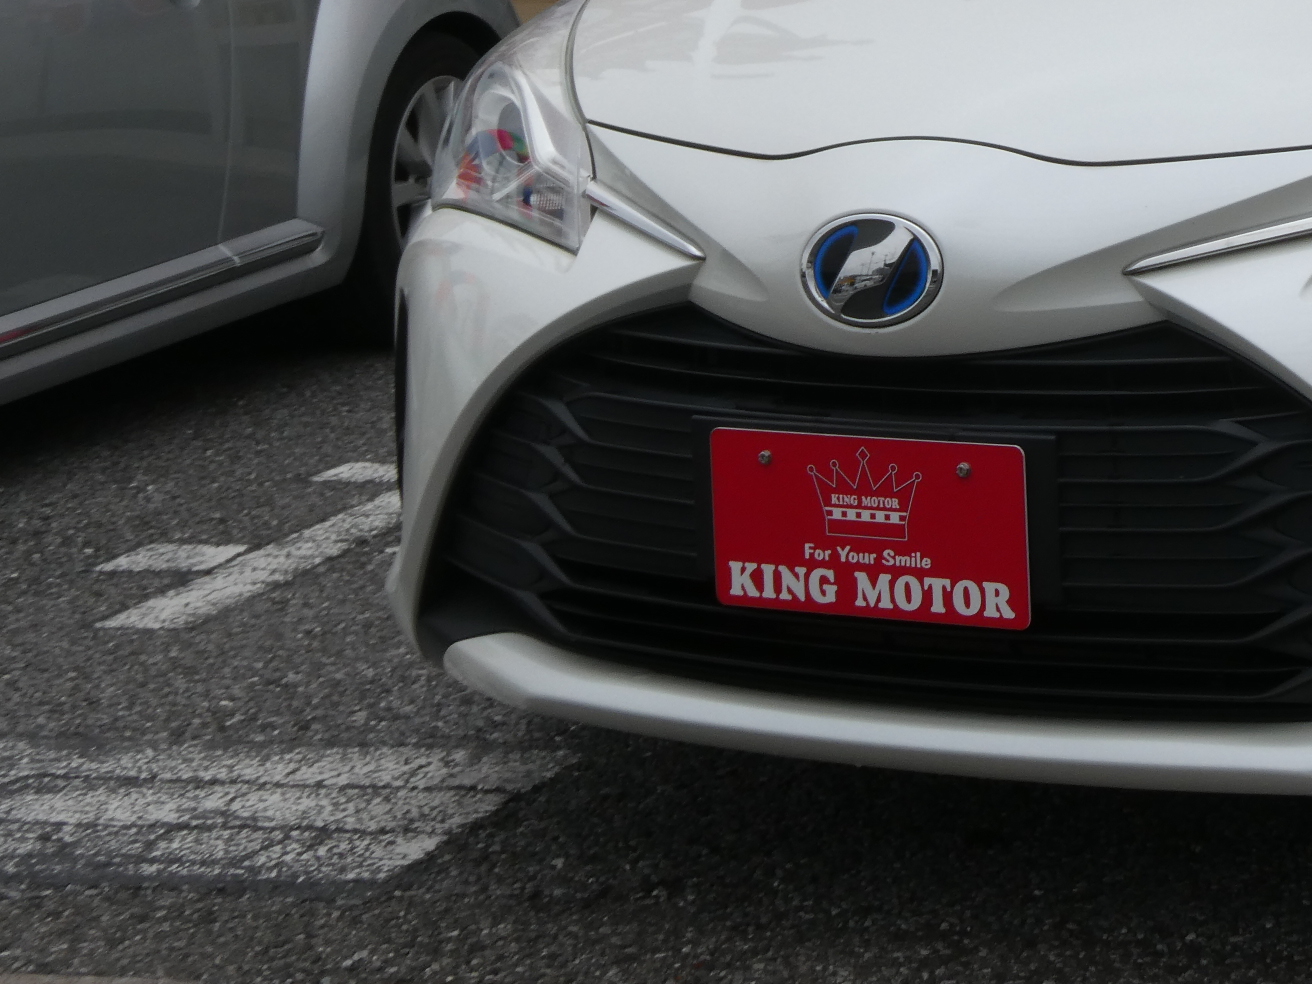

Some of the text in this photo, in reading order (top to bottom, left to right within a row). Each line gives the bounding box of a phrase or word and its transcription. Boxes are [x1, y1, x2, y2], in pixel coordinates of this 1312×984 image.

[831, 494, 900, 509] KING MOTOR
[804, 543, 931, 569] For Your Smile
[728, 561, 1016, 620] KING MOTOR
